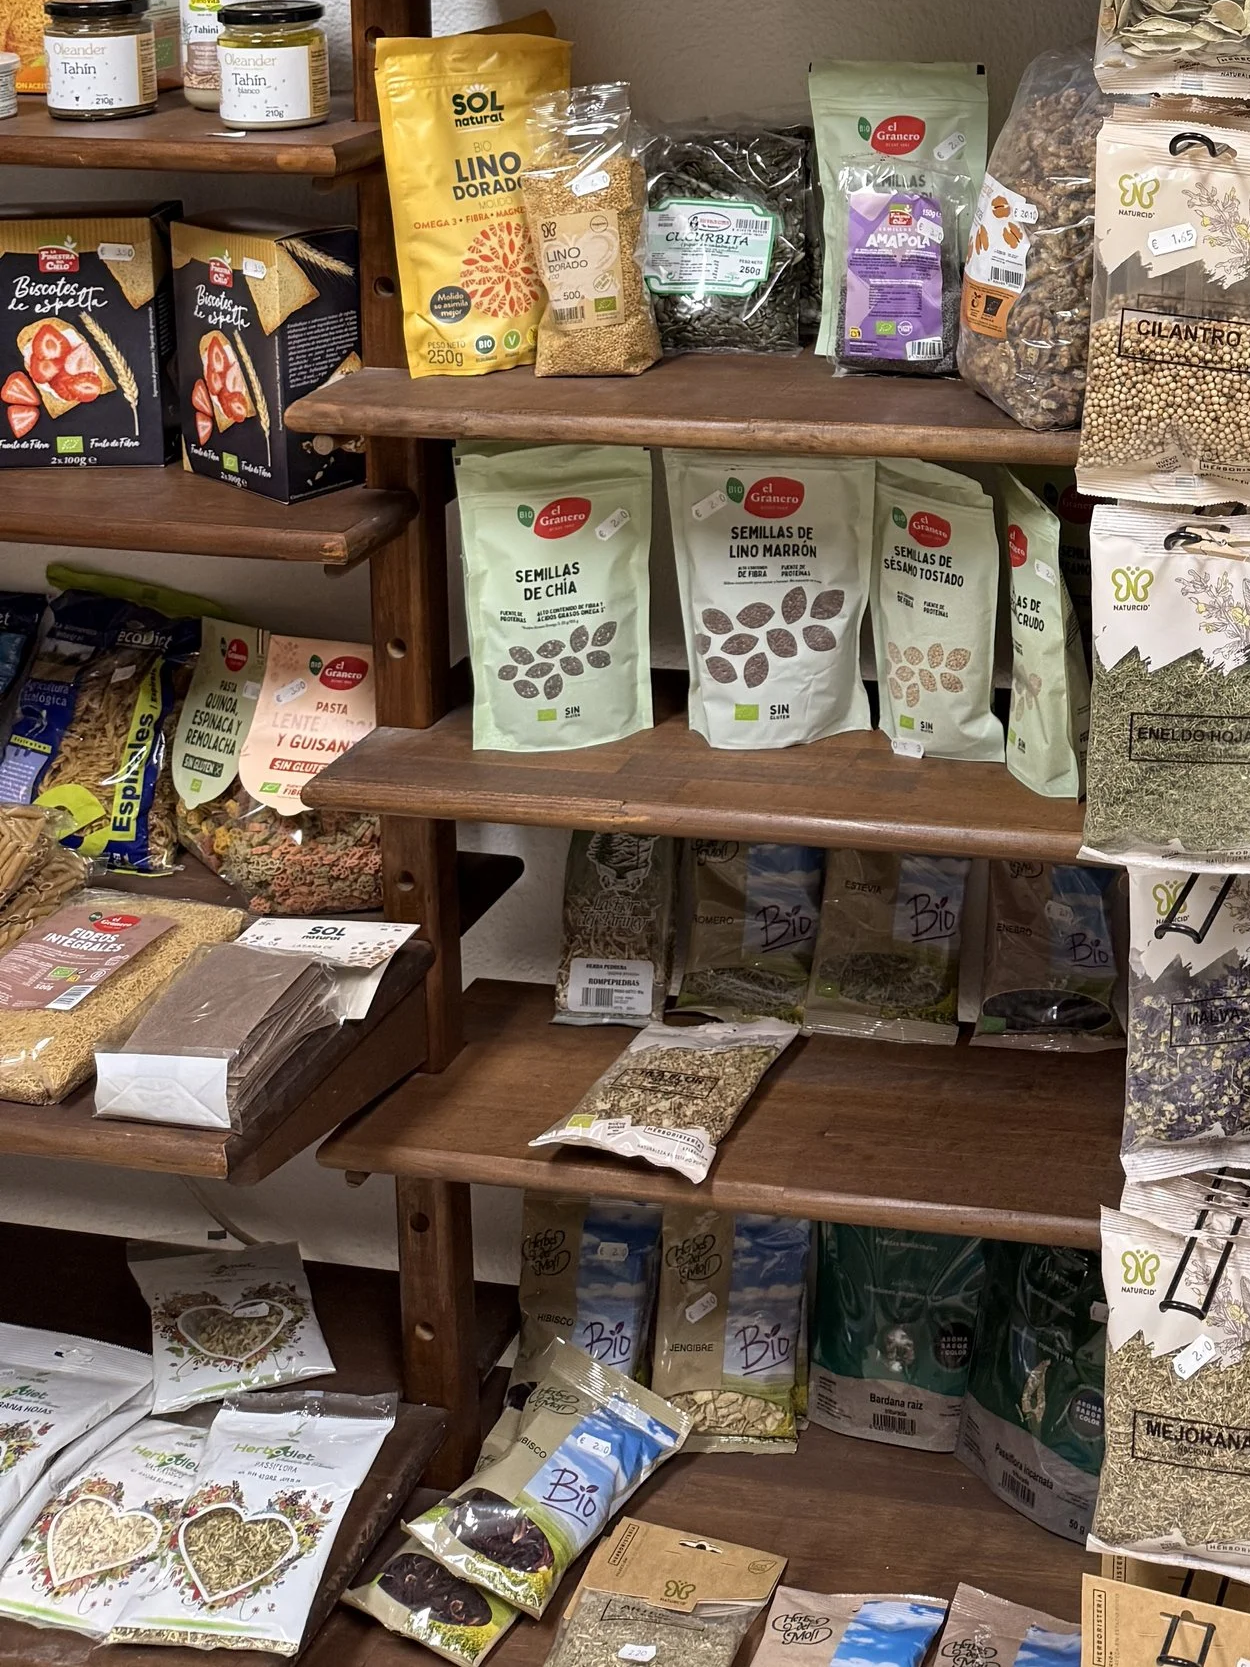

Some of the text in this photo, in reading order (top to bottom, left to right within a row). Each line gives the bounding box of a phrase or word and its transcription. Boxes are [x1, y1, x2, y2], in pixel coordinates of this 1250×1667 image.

[193, 25, 218, 34] Tahini
[224, 53, 277, 66] Oleander
[232, 73, 266, 86] Tahín
[238, 87, 260, 95] blanco
[452, 92, 504, 115] SOL
[266, 109, 283, 118] 210g
[455, 112, 504, 127] natural
[877, 131, 920, 142] Granero
[455, 152, 521, 183] LINO
[866, 233, 930, 248] AMAPOLA
[13, 276, 78, 298] Biscotes
[8, 286, 107, 313] de espelta
[1137, 320, 1242, 347] CILANTRO
[428, 348, 464, 366] 250g
[540, 513, 585, 526] Granero
[731, 527, 813, 540] SEMILLAS DE
[729, 542, 817, 558] LINO MARRÓN
[894, 545, 952, 568] SEMILLAS DE
[515, 562, 580, 583] SEMILLAS
[884, 557, 964, 587] SÉSAMO TOSTADO
[524, 577, 578, 601] DE CHÍA
[206, 694, 238, 716] QUINOA,
[192, 710, 242, 736] ESPINACA Y
[185, 729, 236, 756] REMOLACHA
[1137, 727, 1203, 743] ENELDO
[72, 927, 119, 943] FIDEOS
[42, 933, 125, 954] INTEGRALES
[588, 978, 639, 986] ROMPEPIEDRAS
[1186, 1008, 1242, 1027] MALVA
[669, 1342, 714, 1353] JENGIBRE
[869, 1392, 905, 1408] Bardana
